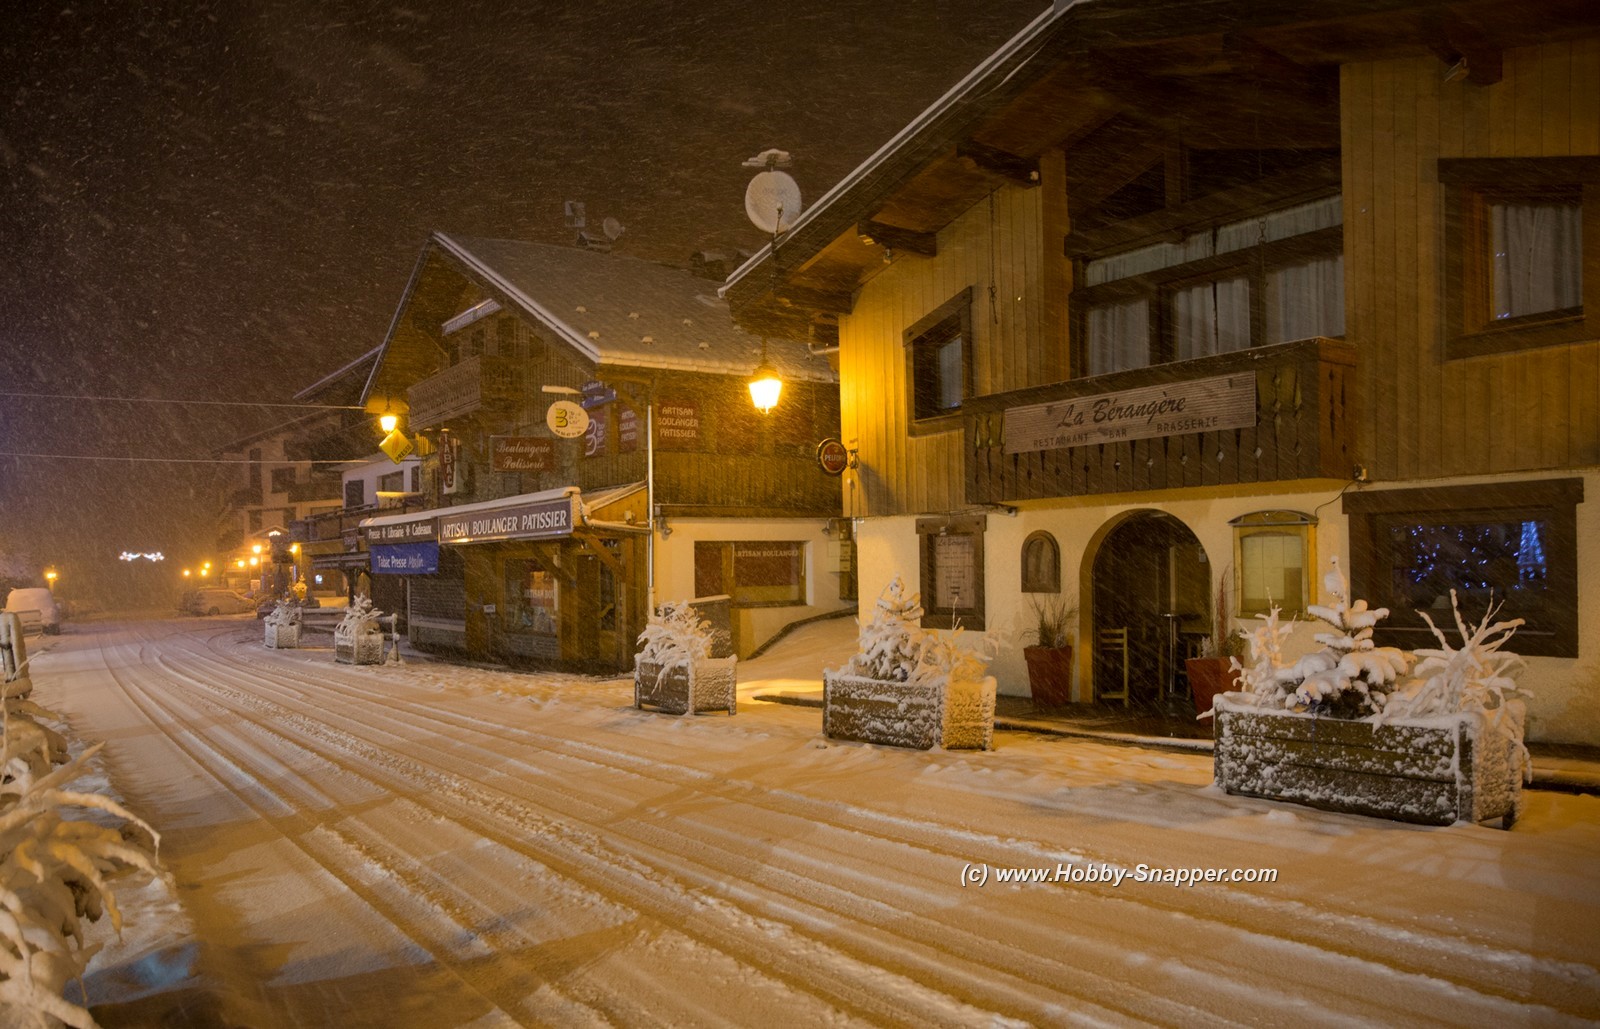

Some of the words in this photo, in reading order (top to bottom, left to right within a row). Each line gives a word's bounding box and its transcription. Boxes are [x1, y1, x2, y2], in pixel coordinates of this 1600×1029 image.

[662, 407, 694, 416] ARTISAN
[1057, 404, 1085, 428] La
[1092, 391, 1186, 424] Bérangère
[657, 417, 699, 428] BOULANGER
[660, 429, 697, 438] PATISSIER
[1033, 432, 1089, 448] RESTAURANT
[1109, 428, 1127, 439] BAR
[1156, 416, 1219, 433] BRASSERIE
[496, 440, 550, 458] Boulangerie
[443, 433, 453, 484] TABAC
[503, 456, 545, 469] Patisserie
[368, 529, 380, 539] Presse
[387, 526, 404, 539] Librairie
[412, 523, 432, 536] Cadeaux
[442, 522, 470, 538] ARTISAN
[472, 516, 518, 535] BOULANGER
[521, 510, 567, 531] PATISSIER
[377, 555, 390, 568] Tabac
[391, 556, 407, 568] Presse
